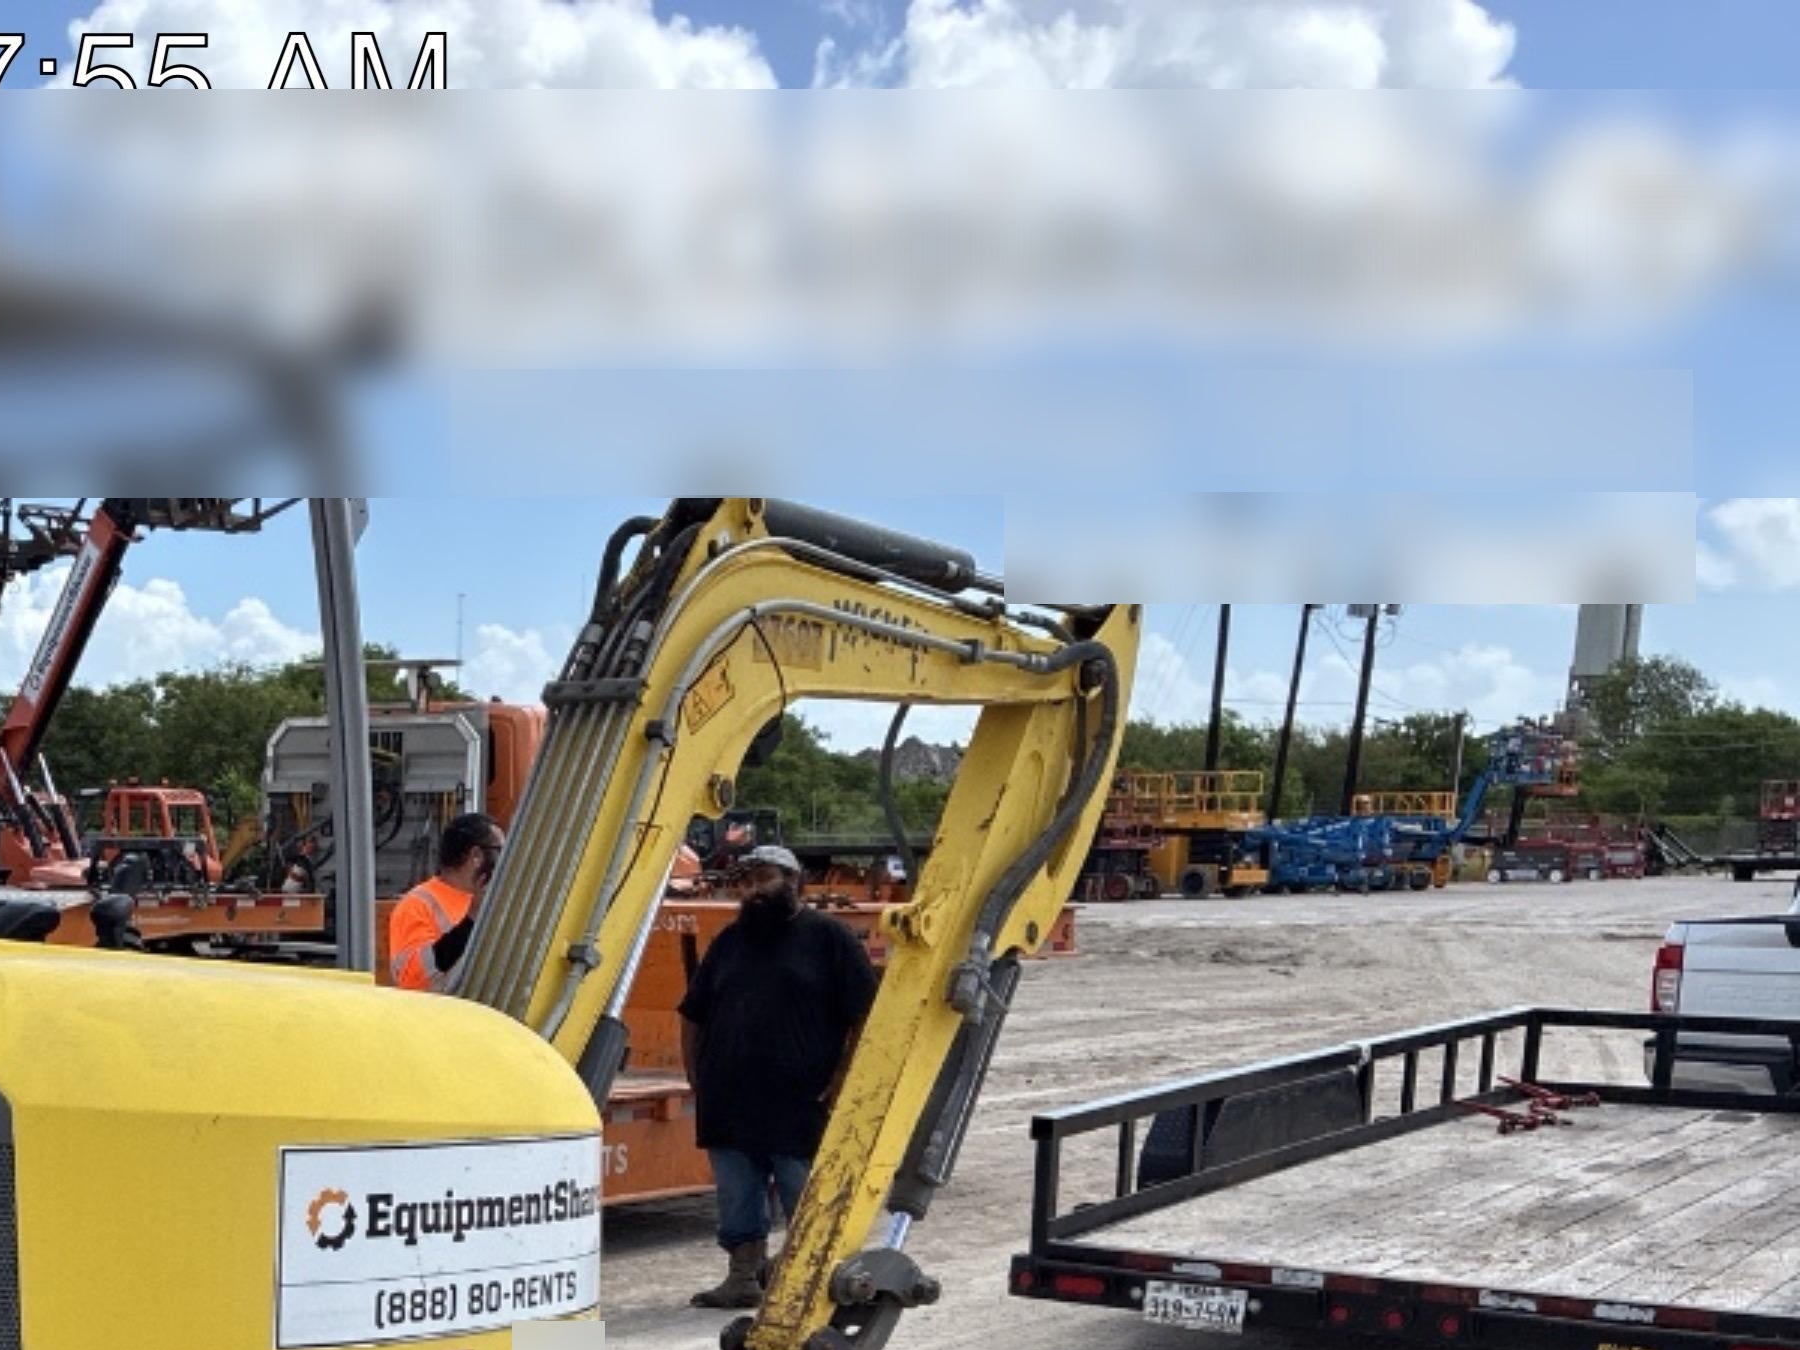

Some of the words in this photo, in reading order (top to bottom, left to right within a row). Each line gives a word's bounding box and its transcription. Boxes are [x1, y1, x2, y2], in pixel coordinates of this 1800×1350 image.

[653, 913, 699, 933] om
[375, 1283, 457, 1329] (888)
[467, 1271, 577, 1316] 80-RENTS
